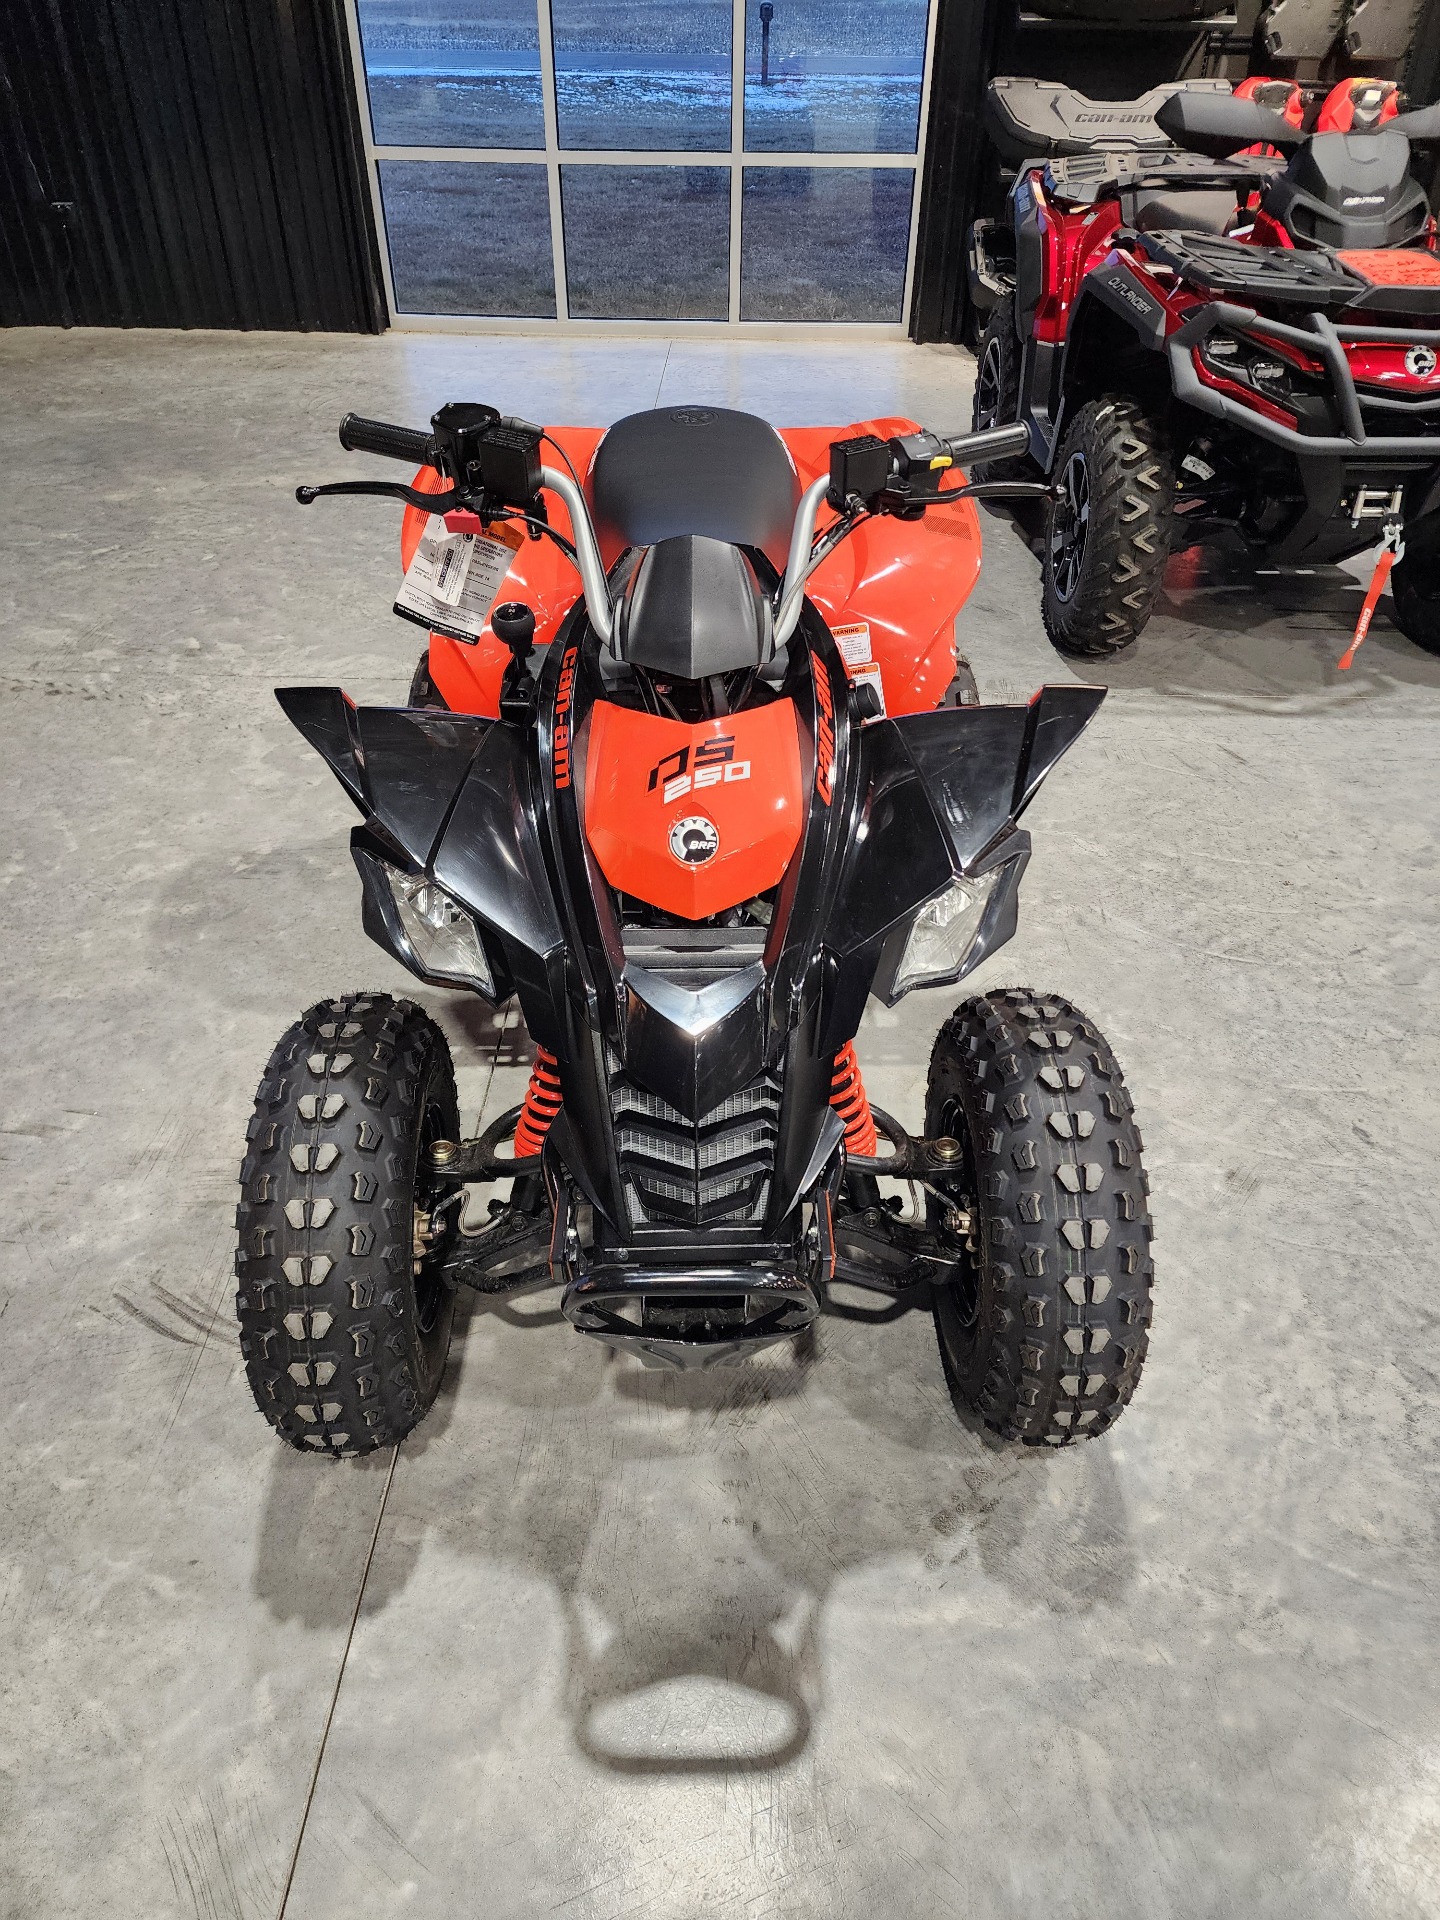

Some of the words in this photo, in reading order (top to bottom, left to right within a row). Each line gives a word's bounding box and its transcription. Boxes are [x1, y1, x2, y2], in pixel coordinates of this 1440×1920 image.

[1074, 113, 1153, 123] can-am
[1107, 277, 1154, 315] OUTLANDER
[555, 646, 578, 789] can-am
[811, 650, 834, 807] can-am
[663, 760, 751, 805] 250
[688, 840, 717, 850] BRP
